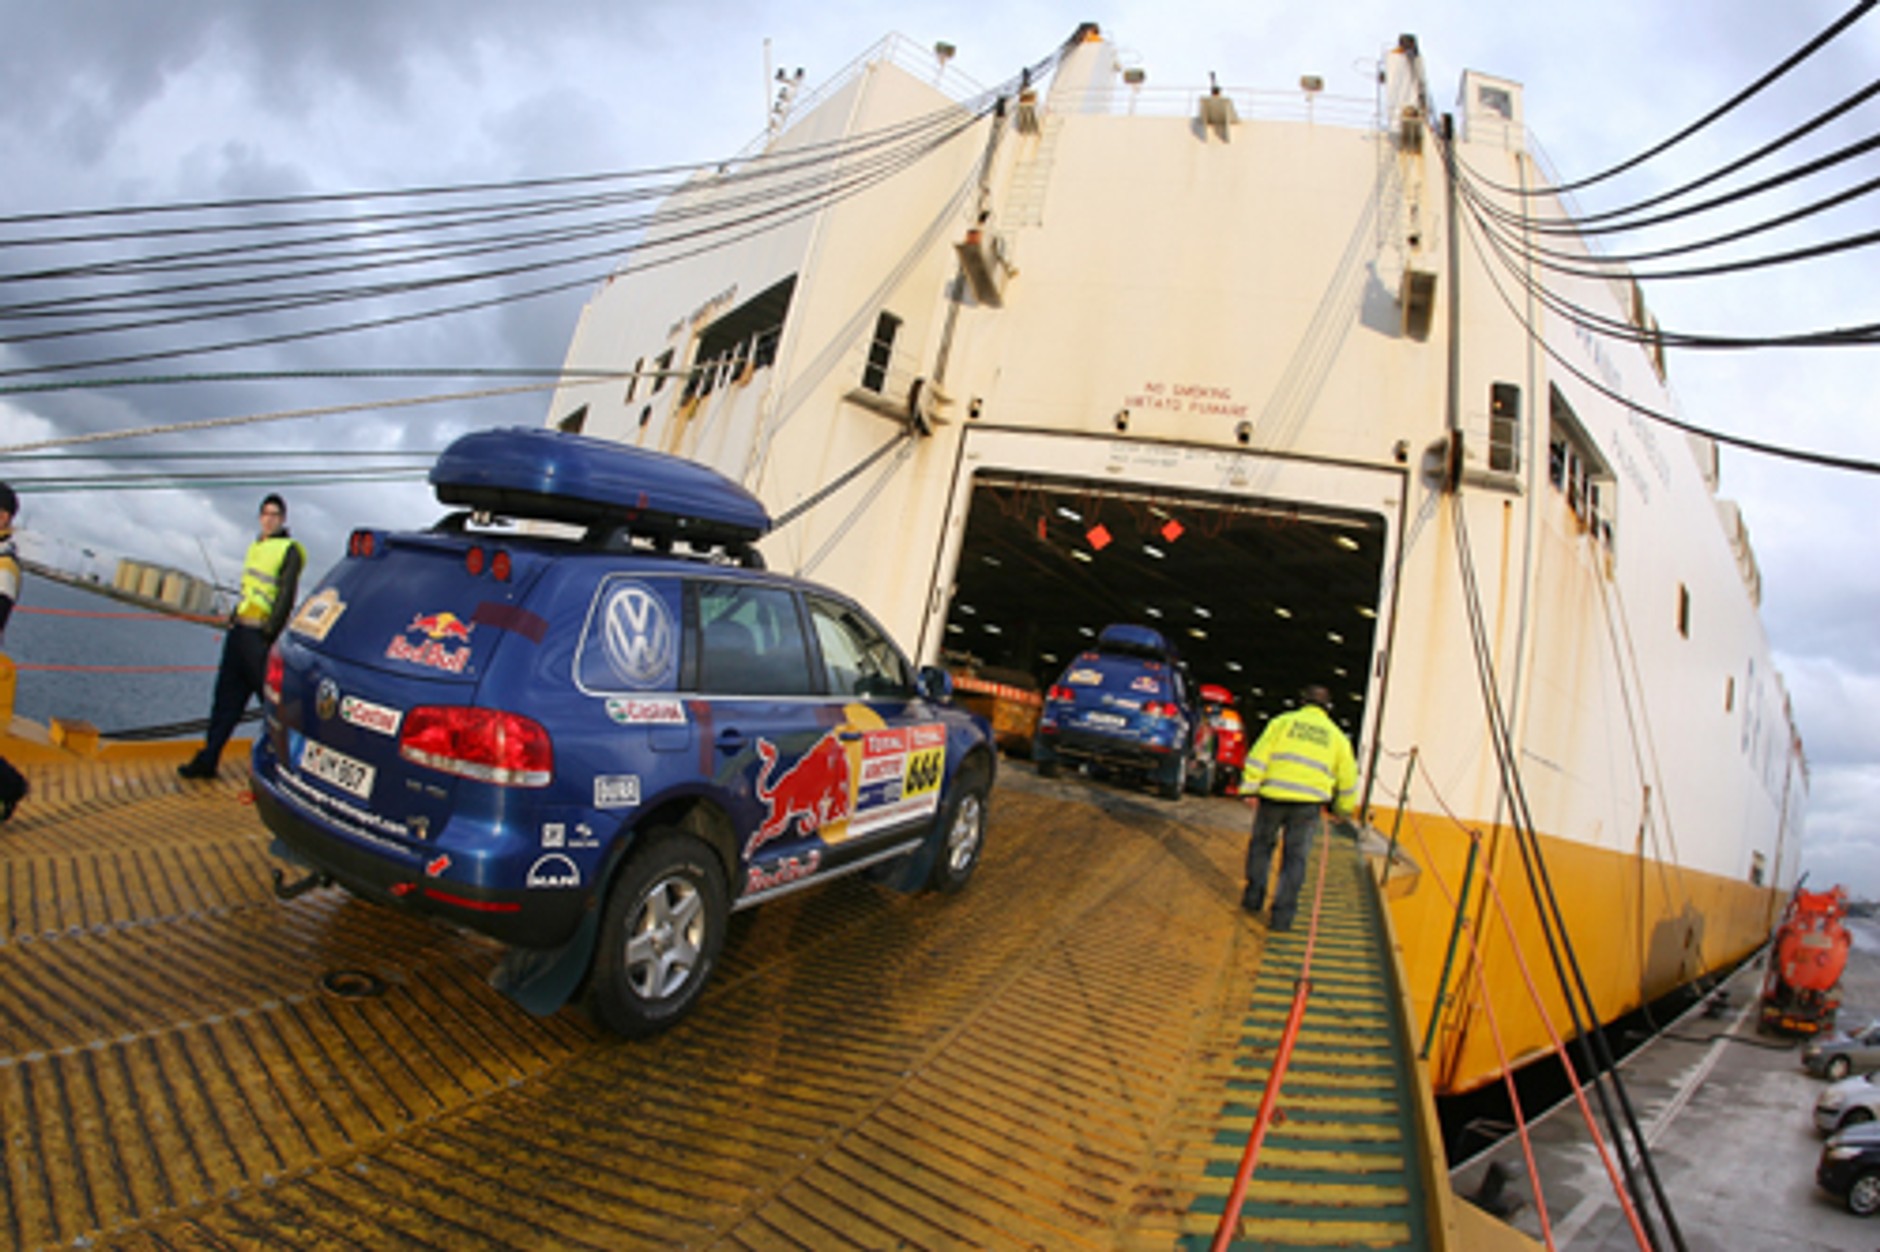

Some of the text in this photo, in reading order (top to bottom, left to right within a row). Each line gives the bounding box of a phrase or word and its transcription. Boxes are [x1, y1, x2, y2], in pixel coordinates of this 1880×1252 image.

[1144, 381, 1232, 401] NO SMOKING
[385, 634, 472, 674] Red Bull
